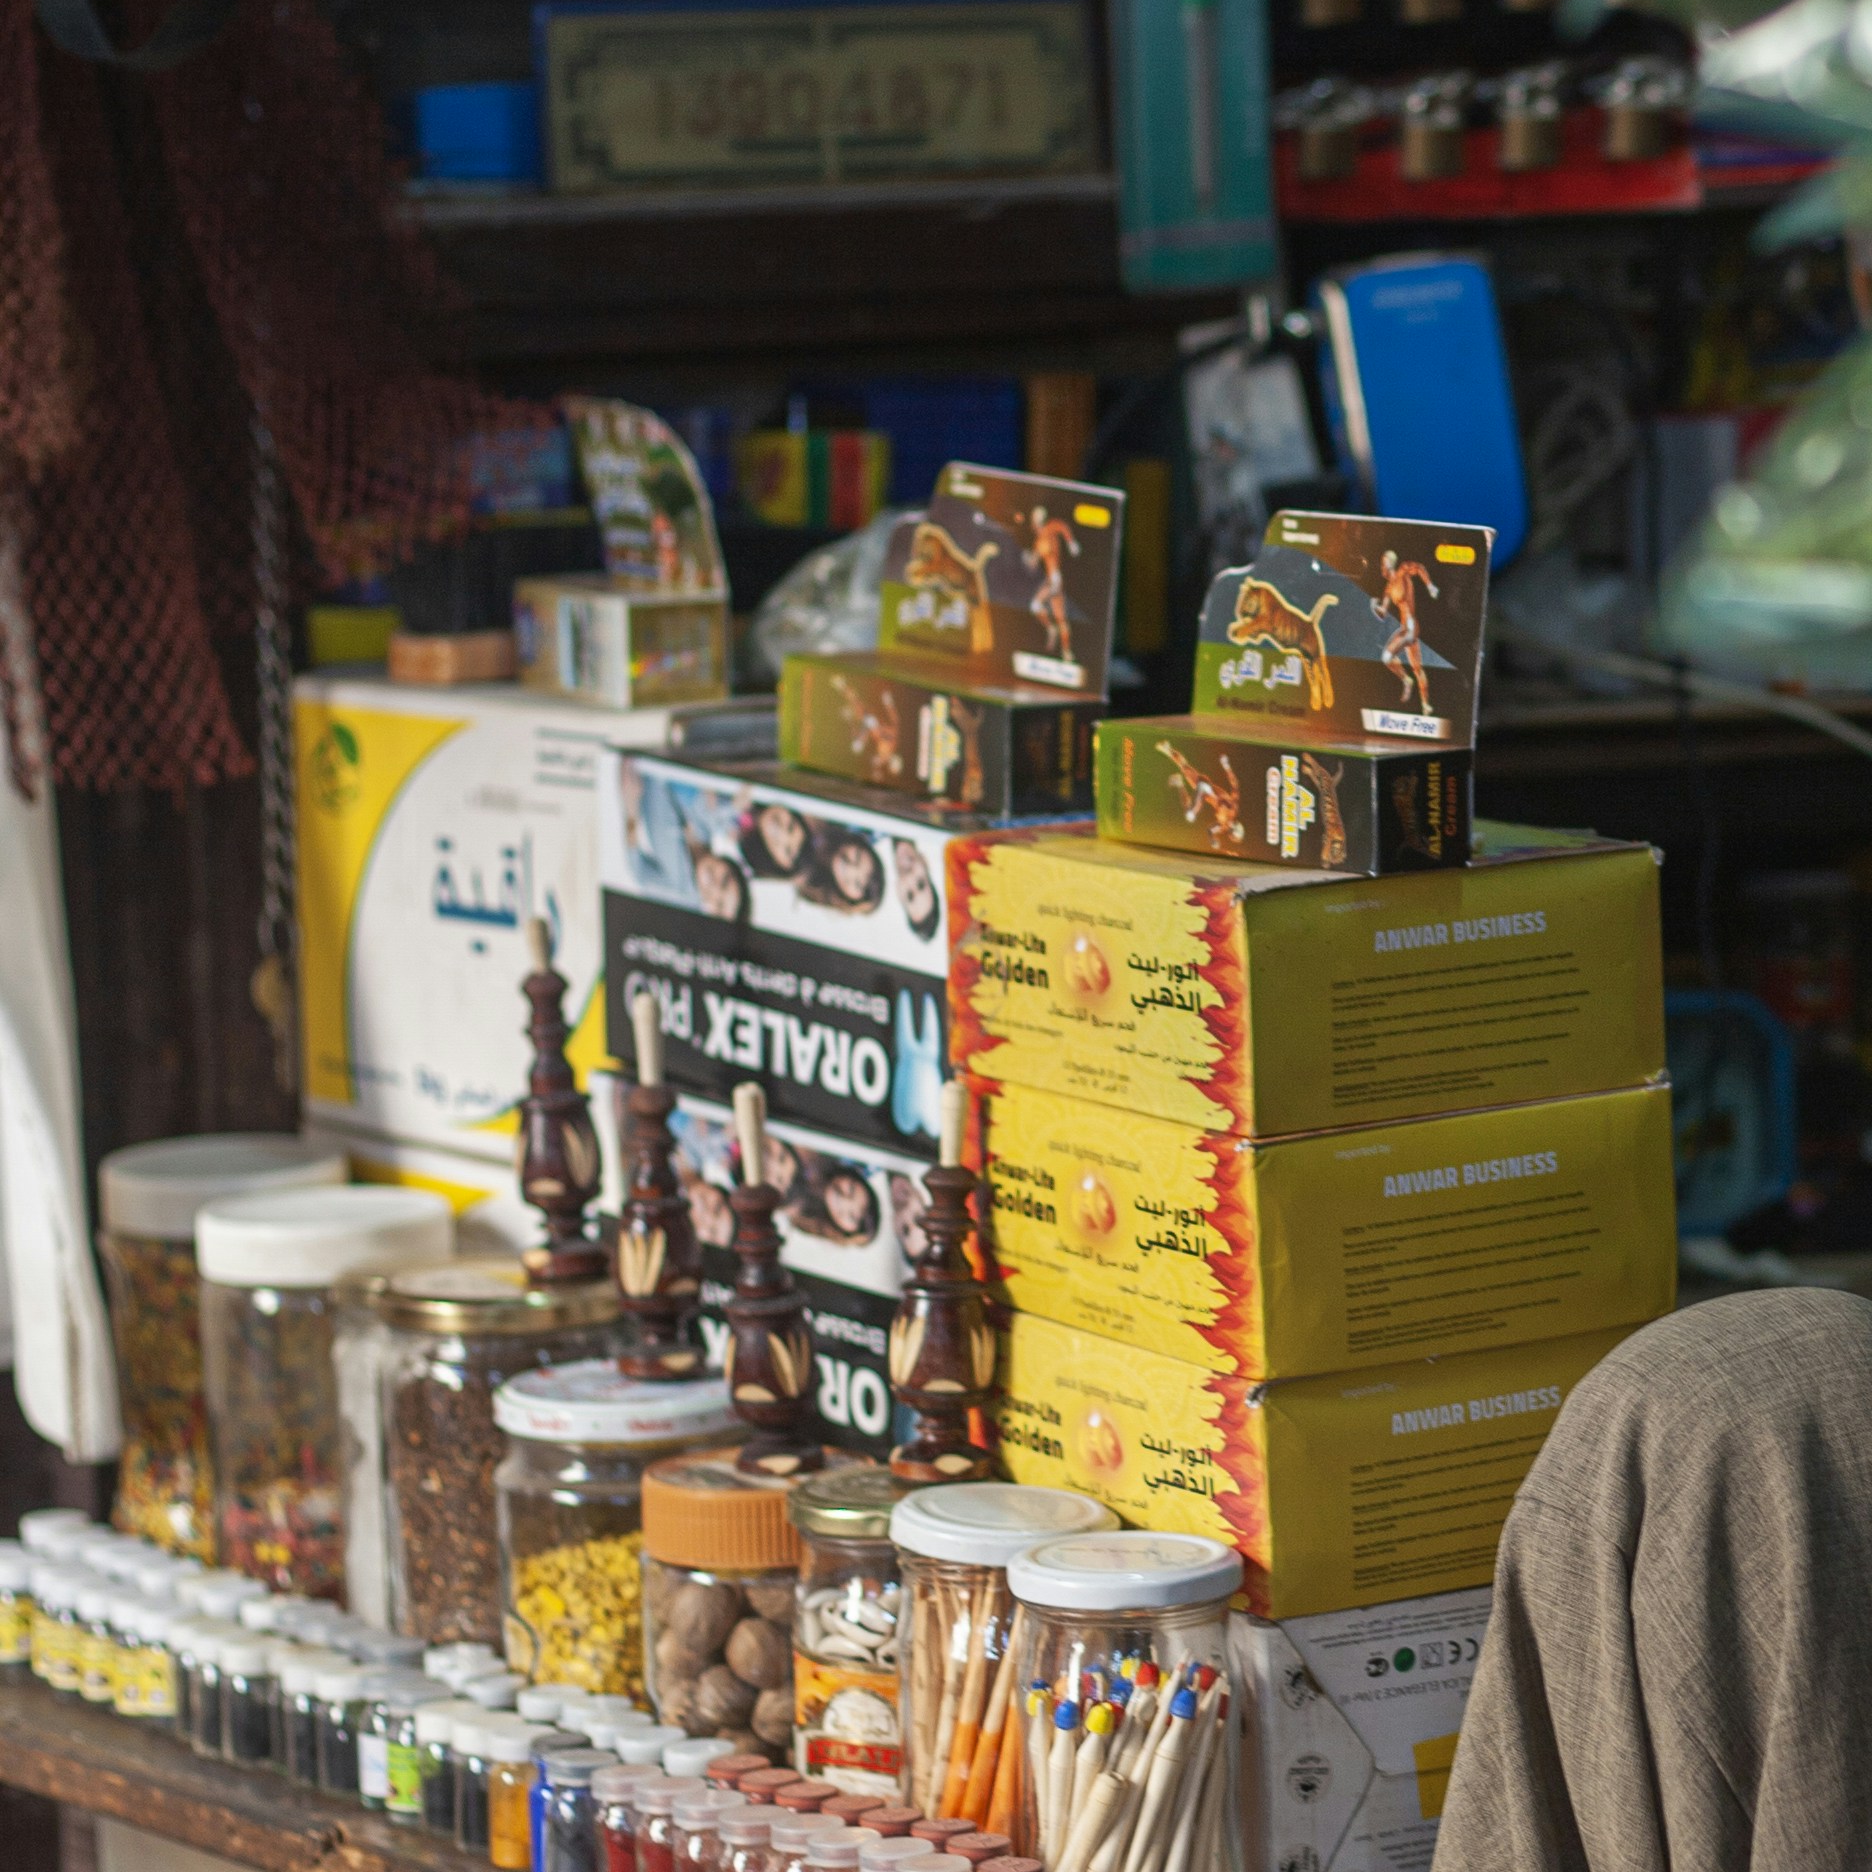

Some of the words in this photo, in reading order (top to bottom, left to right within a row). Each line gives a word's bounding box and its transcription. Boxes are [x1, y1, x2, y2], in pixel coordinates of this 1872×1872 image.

[1280, 754, 1299, 859] NAMIR
[1296, 783, 1315, 831] AL
[1374, 922, 1449, 954] ANWAR
[1453, 910, 1549, 944] BUSINESS
[980, 950, 1050, 989] Golden
[817, 981, 890, 1025] Brosse
[1130, 985, 1202, 1015] الذهبي
[702, 991, 890, 1107] ORALEX
[1383, 1166, 1459, 1199] ANWAR
[1462, 1151, 1560, 1186] BUSINESS
[991, 1183, 1057, 1225] Golden
[1135, 1227, 1208, 1258] الذهبي
[1391, 1402, 1467, 1435] ANWAR
[1468, 1385, 1562, 1424] BUSINESS
[1143, 1468, 1216, 1500] الذهبي
